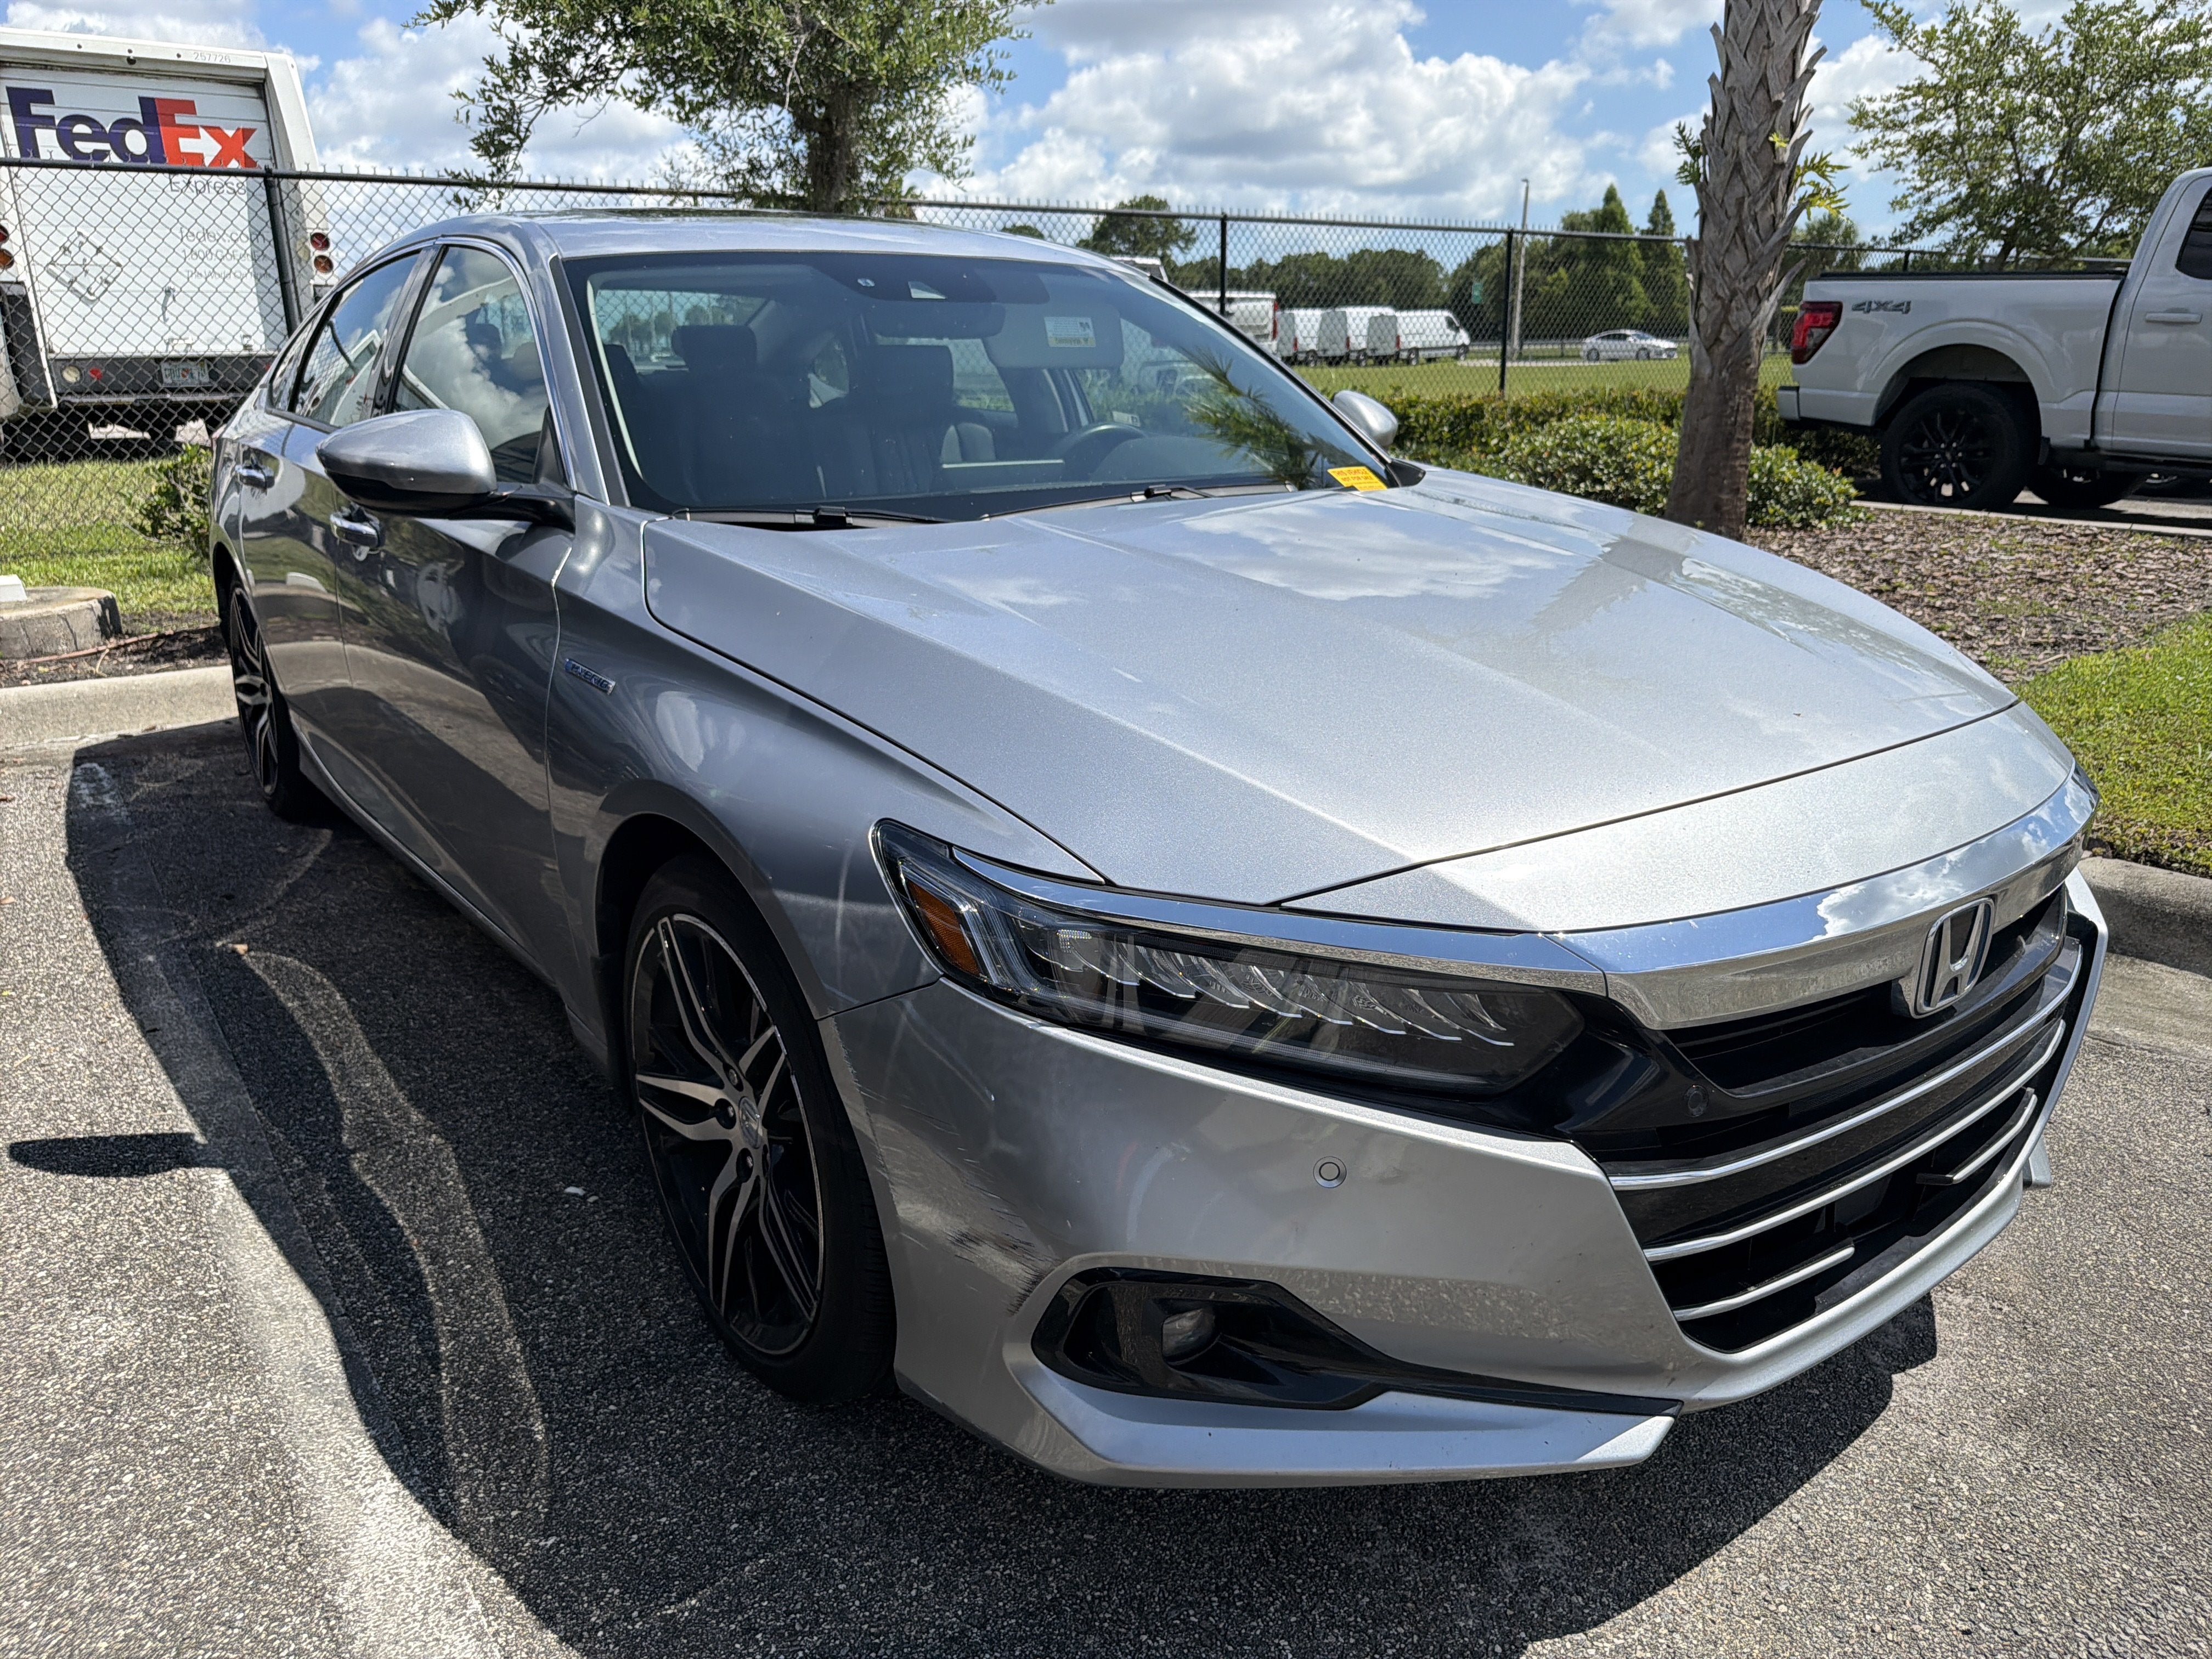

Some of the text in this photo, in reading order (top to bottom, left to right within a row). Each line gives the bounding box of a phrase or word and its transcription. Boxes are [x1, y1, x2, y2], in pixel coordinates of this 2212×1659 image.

[6, 86, 260, 168] FedEx
[168, 174, 247, 195] Express
[180, 227, 266, 244] fedex.com
[571, 664, 608, 689] HYBRID
